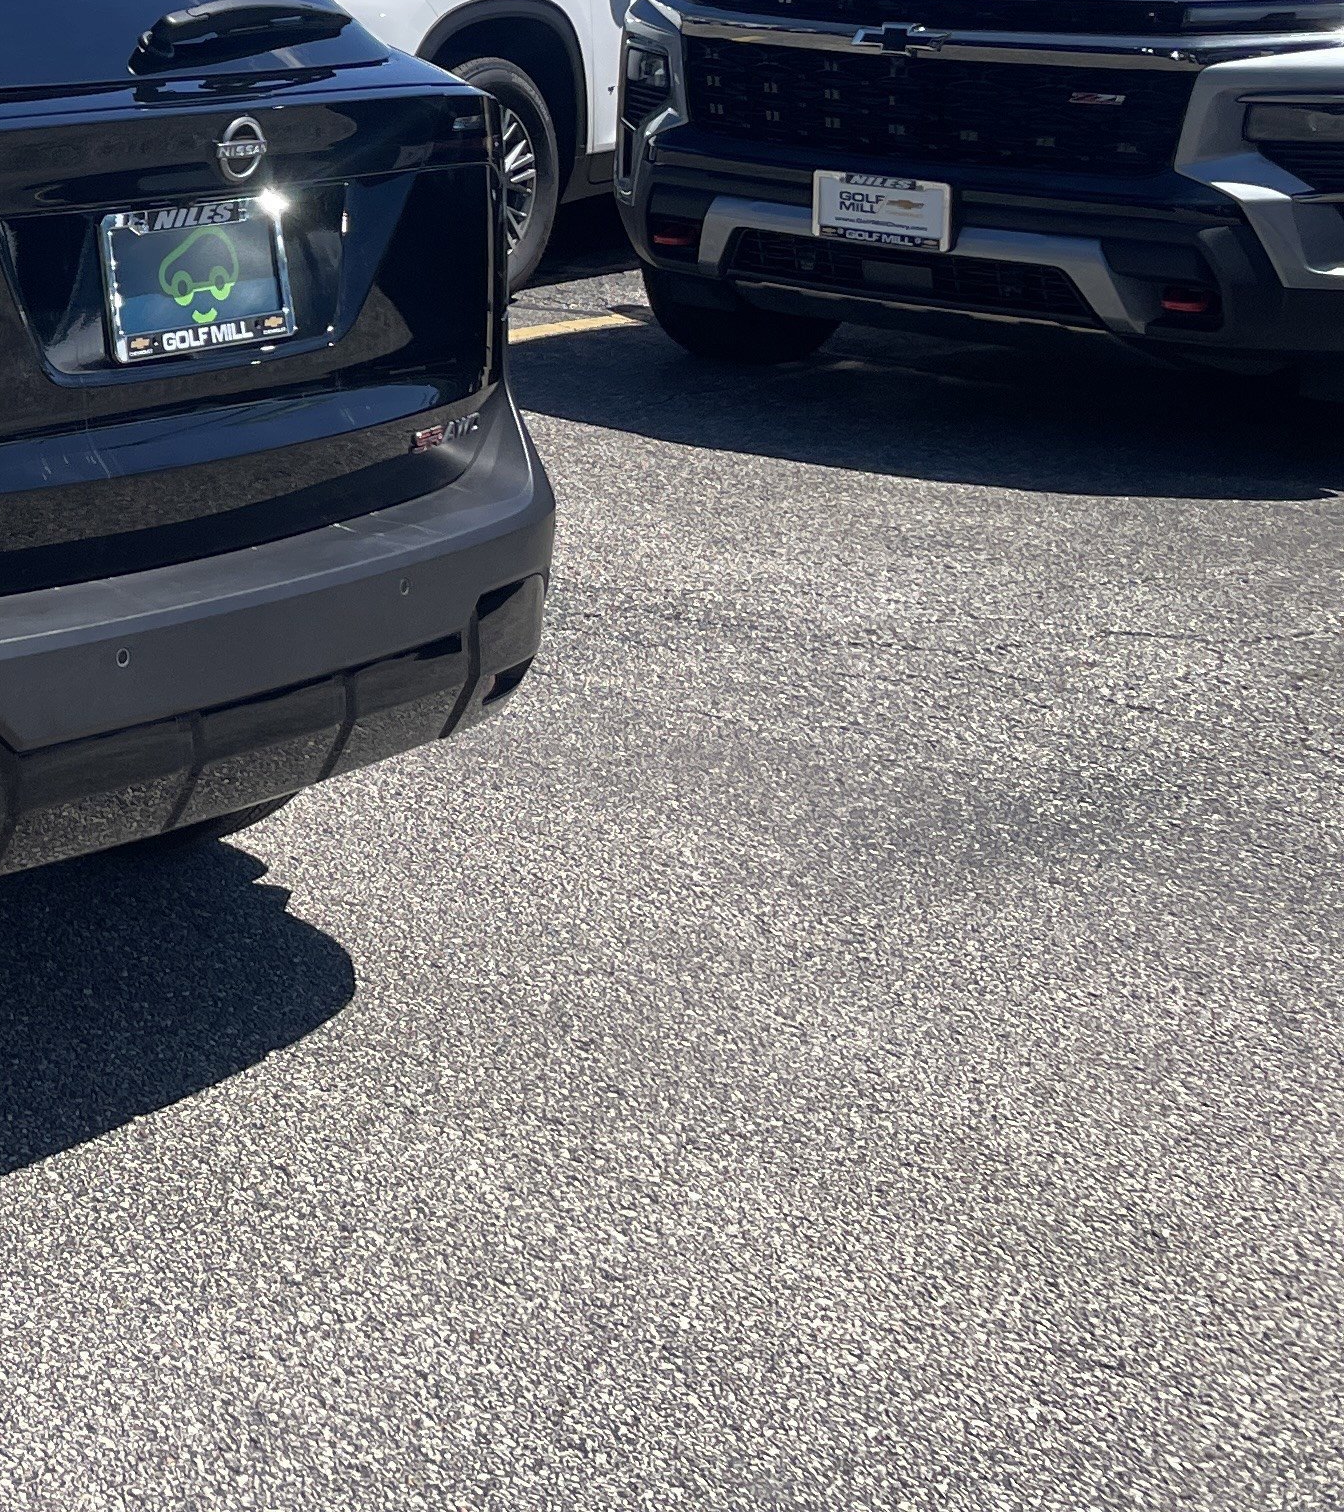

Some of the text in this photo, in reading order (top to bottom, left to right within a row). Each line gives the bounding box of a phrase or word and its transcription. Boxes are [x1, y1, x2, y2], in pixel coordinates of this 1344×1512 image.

[218, 143, 267, 158] NISSAN
[850, 174, 913, 190] NILES
[839, 190, 885, 204] GOLF
[839, 201, 878, 215] MILL
[153, 202, 232, 231] NILES
[845, 229, 914, 247] GOLF MILL
[162, 320, 254, 352] GOLF MILL
